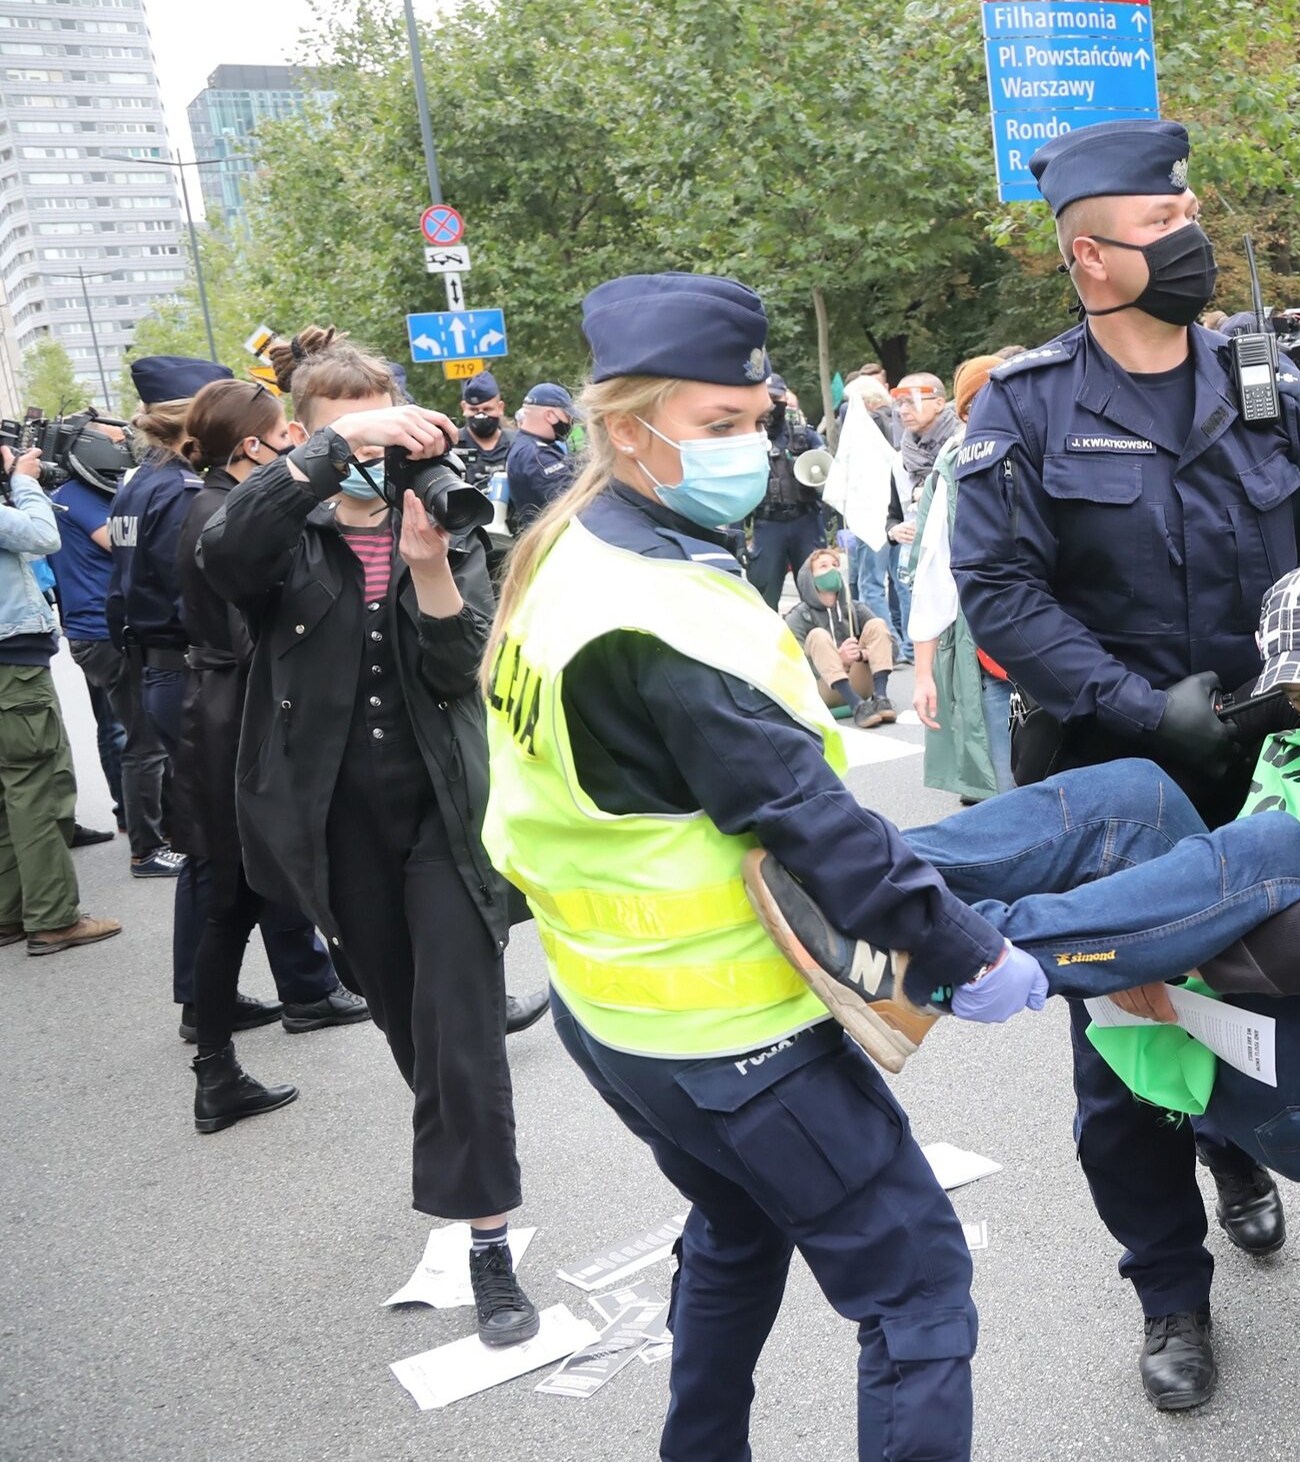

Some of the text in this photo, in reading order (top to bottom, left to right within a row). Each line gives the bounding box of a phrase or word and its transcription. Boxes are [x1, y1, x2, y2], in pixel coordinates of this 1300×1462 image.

[994, 7, 1117, 30] Filharmonia
[999, 44, 1133, 68] Pl. Powstańców
[1000, 76, 1095, 102] Warszawy
[1005, 116, 1071, 140] Rondo
[453, 363, 475, 376] 719
[957, 440, 997, 468] POLICJA
[1071, 438, 1153, 450] J. KWIATKOWSKI
[1070, 949, 1116, 963] simond
